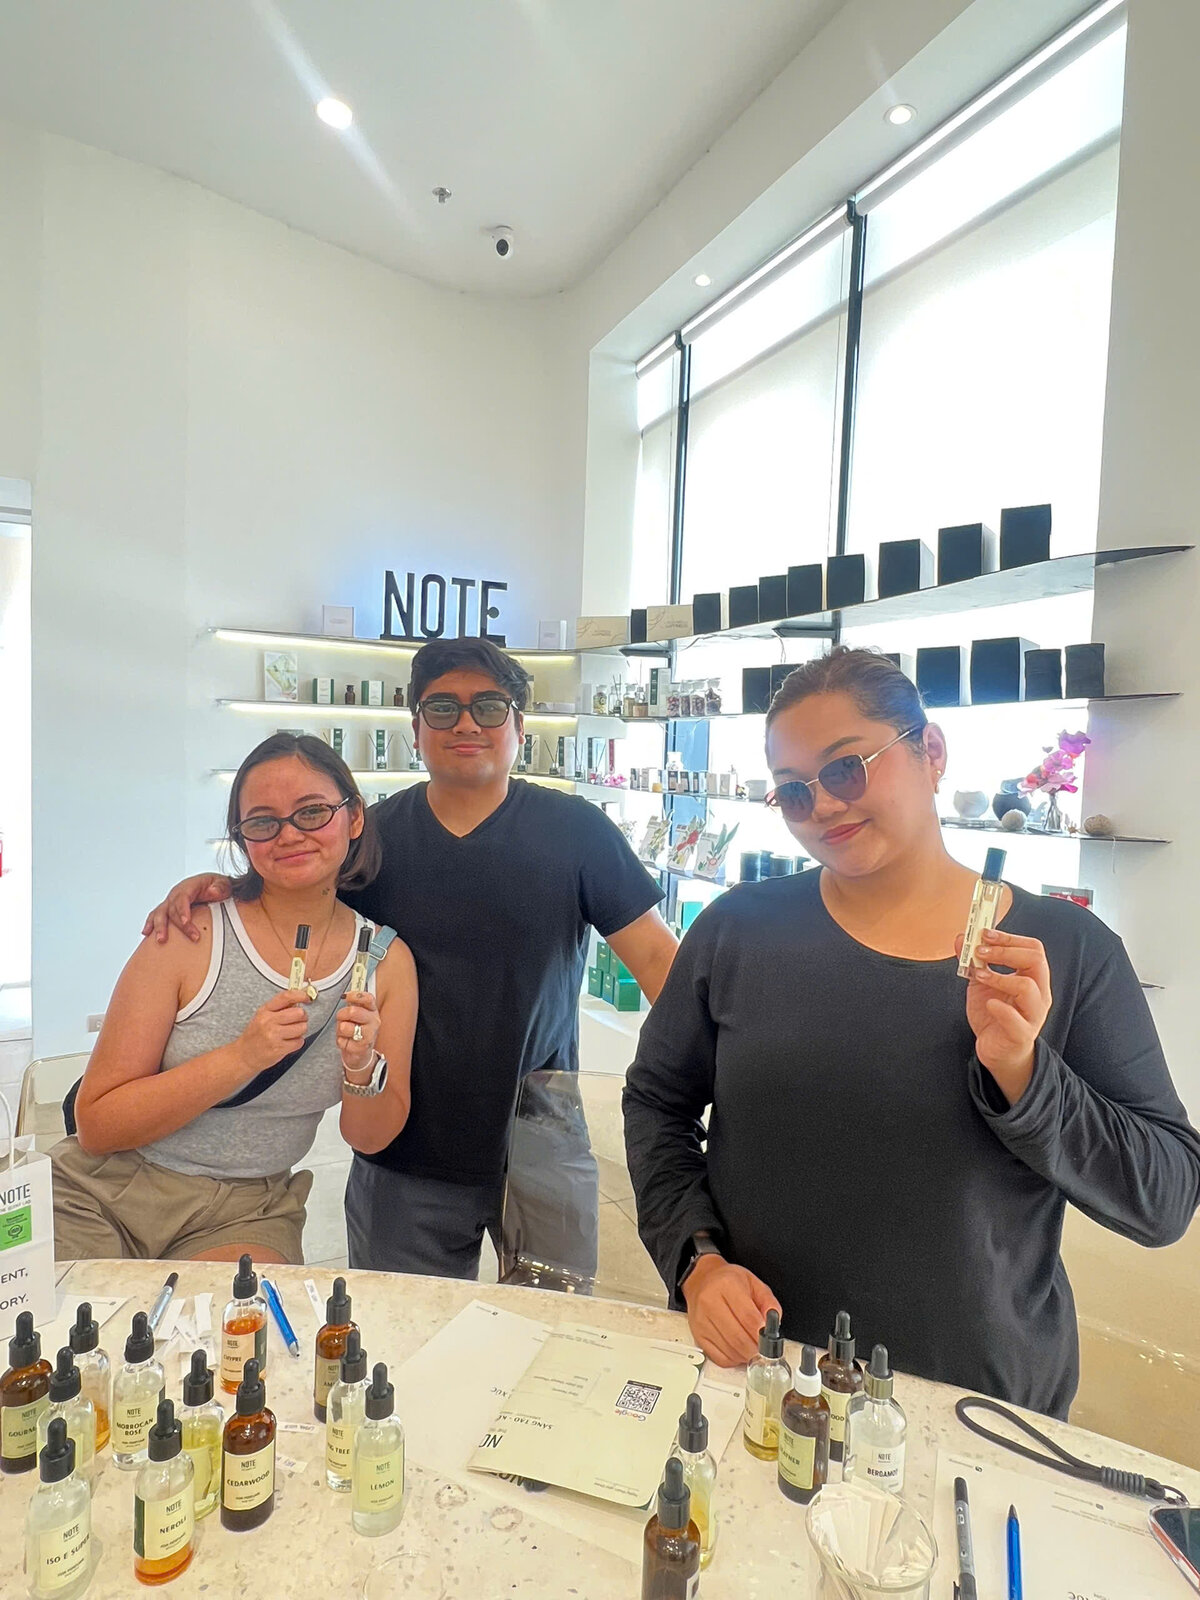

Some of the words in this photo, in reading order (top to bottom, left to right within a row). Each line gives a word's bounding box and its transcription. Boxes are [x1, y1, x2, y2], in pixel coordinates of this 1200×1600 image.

[383, 570, 507, 640] NOTE
[127, 1408, 141, 1416] NOTE
[614, 1408, 647, 1422] Google
[879, 1453, 892, 1461] NOTE
[240, 1459, 256, 1469] NOTE
[376, 1461, 391, 1472] NOTE
[226, 1470, 271, 1487] CEDARWOOD
[370, 1480, 395, 1491] LEMON
[165, 1499, 182, 1514] NOTE
[62, 1523, 80, 1540] NOTE
[159, 1516, 187, 1535] NEROLI
[46, 1555, 61, 1565] ISO
